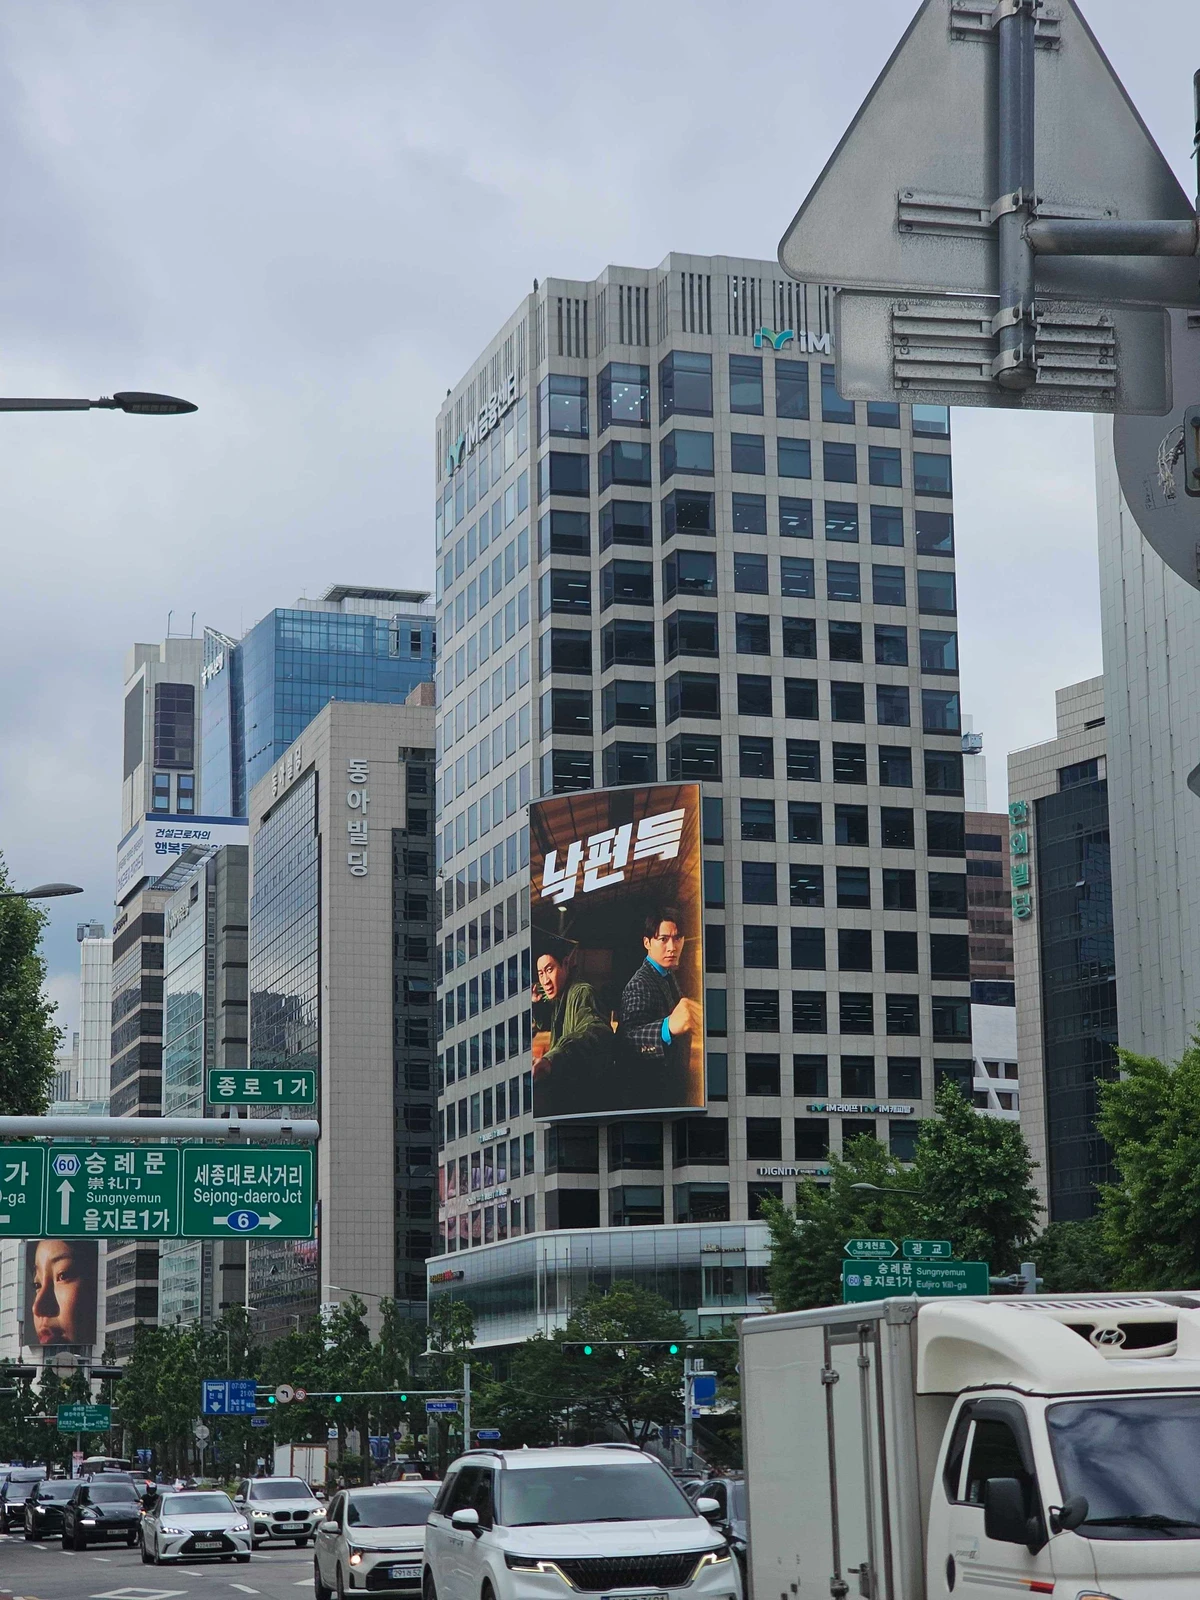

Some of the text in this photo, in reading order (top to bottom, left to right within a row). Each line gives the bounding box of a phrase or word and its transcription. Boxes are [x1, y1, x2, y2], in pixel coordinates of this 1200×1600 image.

[346, 758, 371, 878] 동아빌딩
[155, 828, 211, 840] 건설근로자의
[58, 1159, 75, 1172] 60
[84, 1152, 166, 1175] 숭례문
[194, 1164, 303, 1187] 세종대로사거리
[760, 1166, 800, 1176] DIGNITY
[87, 1177, 142, 1190] 崇礼门
[86, 1192, 162, 1205] Sungnyemun
[193, 1188, 302, 1206] Sejong-daero Jct
[83, 1208, 170, 1231] 을지로1가
[237, 1213, 249, 1228] 6
[856, 1241, 887, 1250] 청계천로
[877, 1263, 913, 1275] 숭례문
[916, 1267, 966, 1277] Sungnyemun
[862, 1275, 913, 1287] 을지로1가
[916, 1281, 940, 1290] Euljiro
